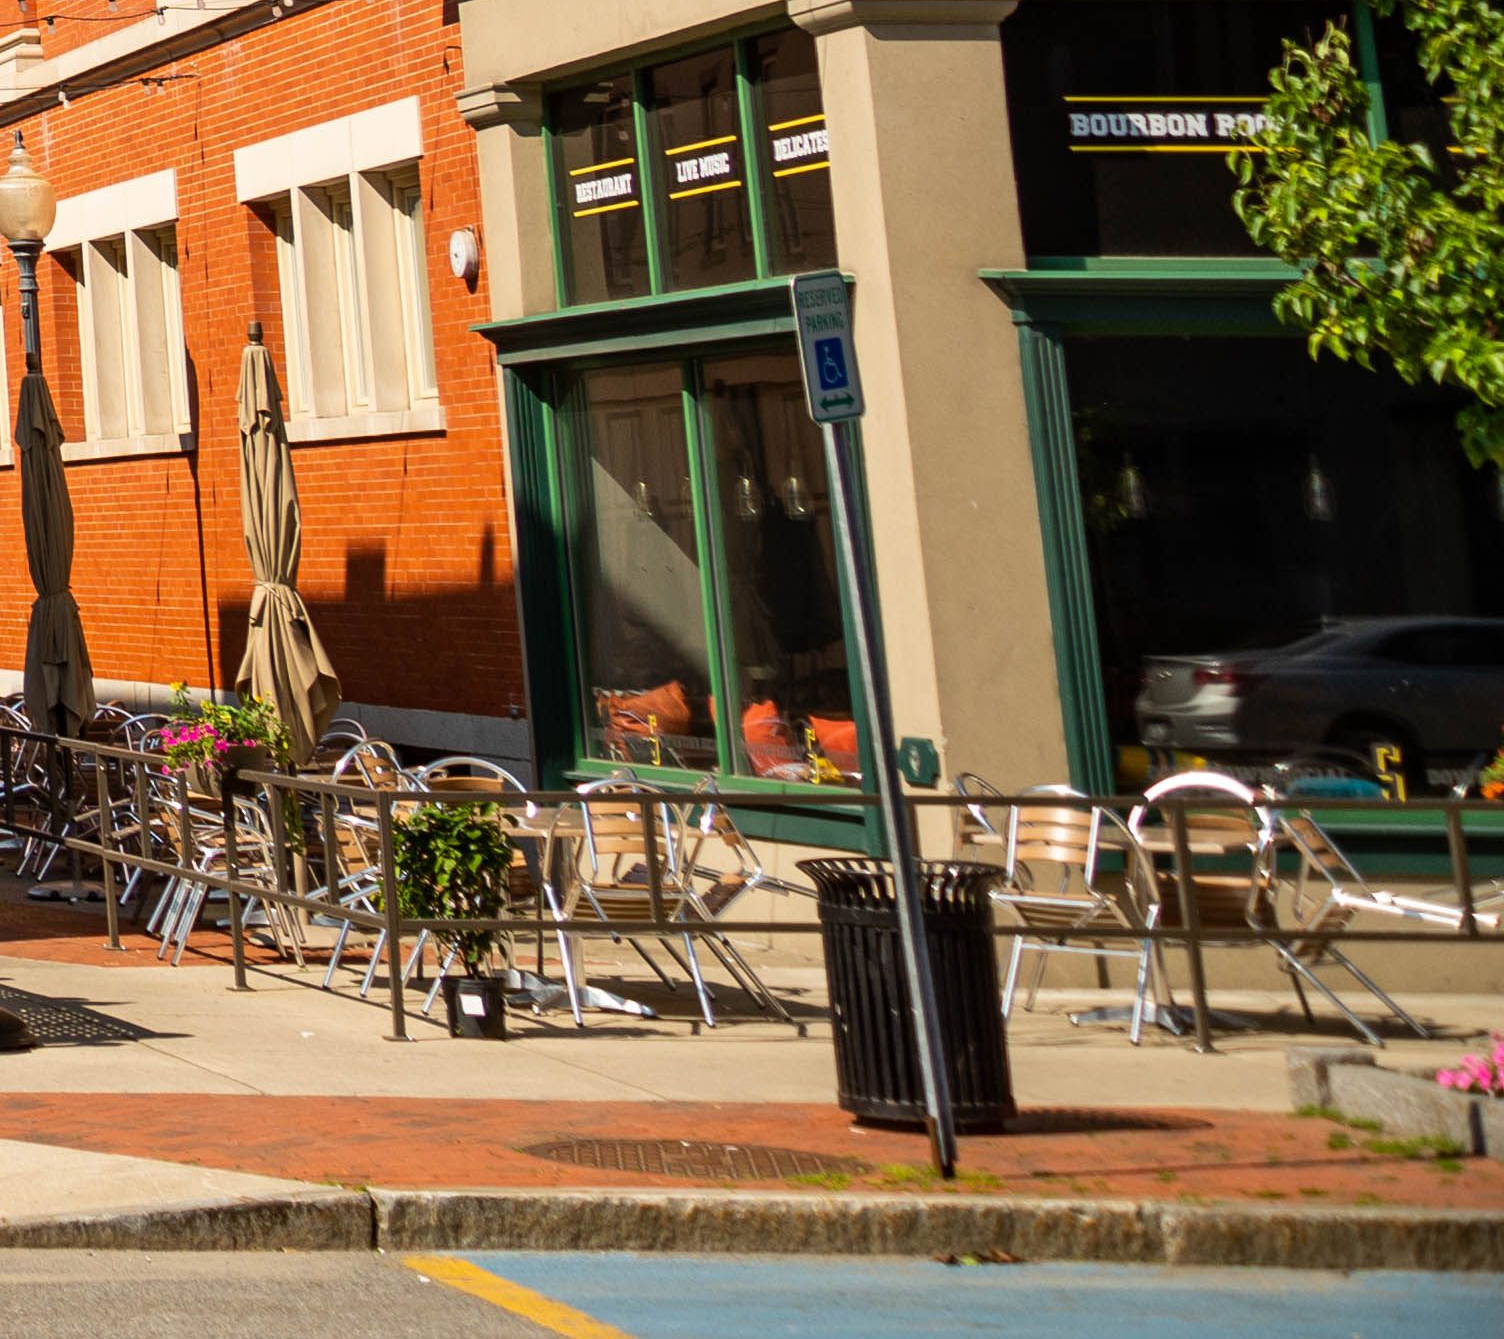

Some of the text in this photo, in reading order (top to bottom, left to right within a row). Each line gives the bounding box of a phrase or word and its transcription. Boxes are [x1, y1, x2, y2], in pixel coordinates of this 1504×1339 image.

[1069, 113, 1290, 137] BOURBON ROO
[675, 152, 730, 183] LIVE MUSIC
[575, 173, 632, 203] RESTAURANT
[798, 286, 845, 309] RESERVED
[805, 312, 845, 333] PARKING
